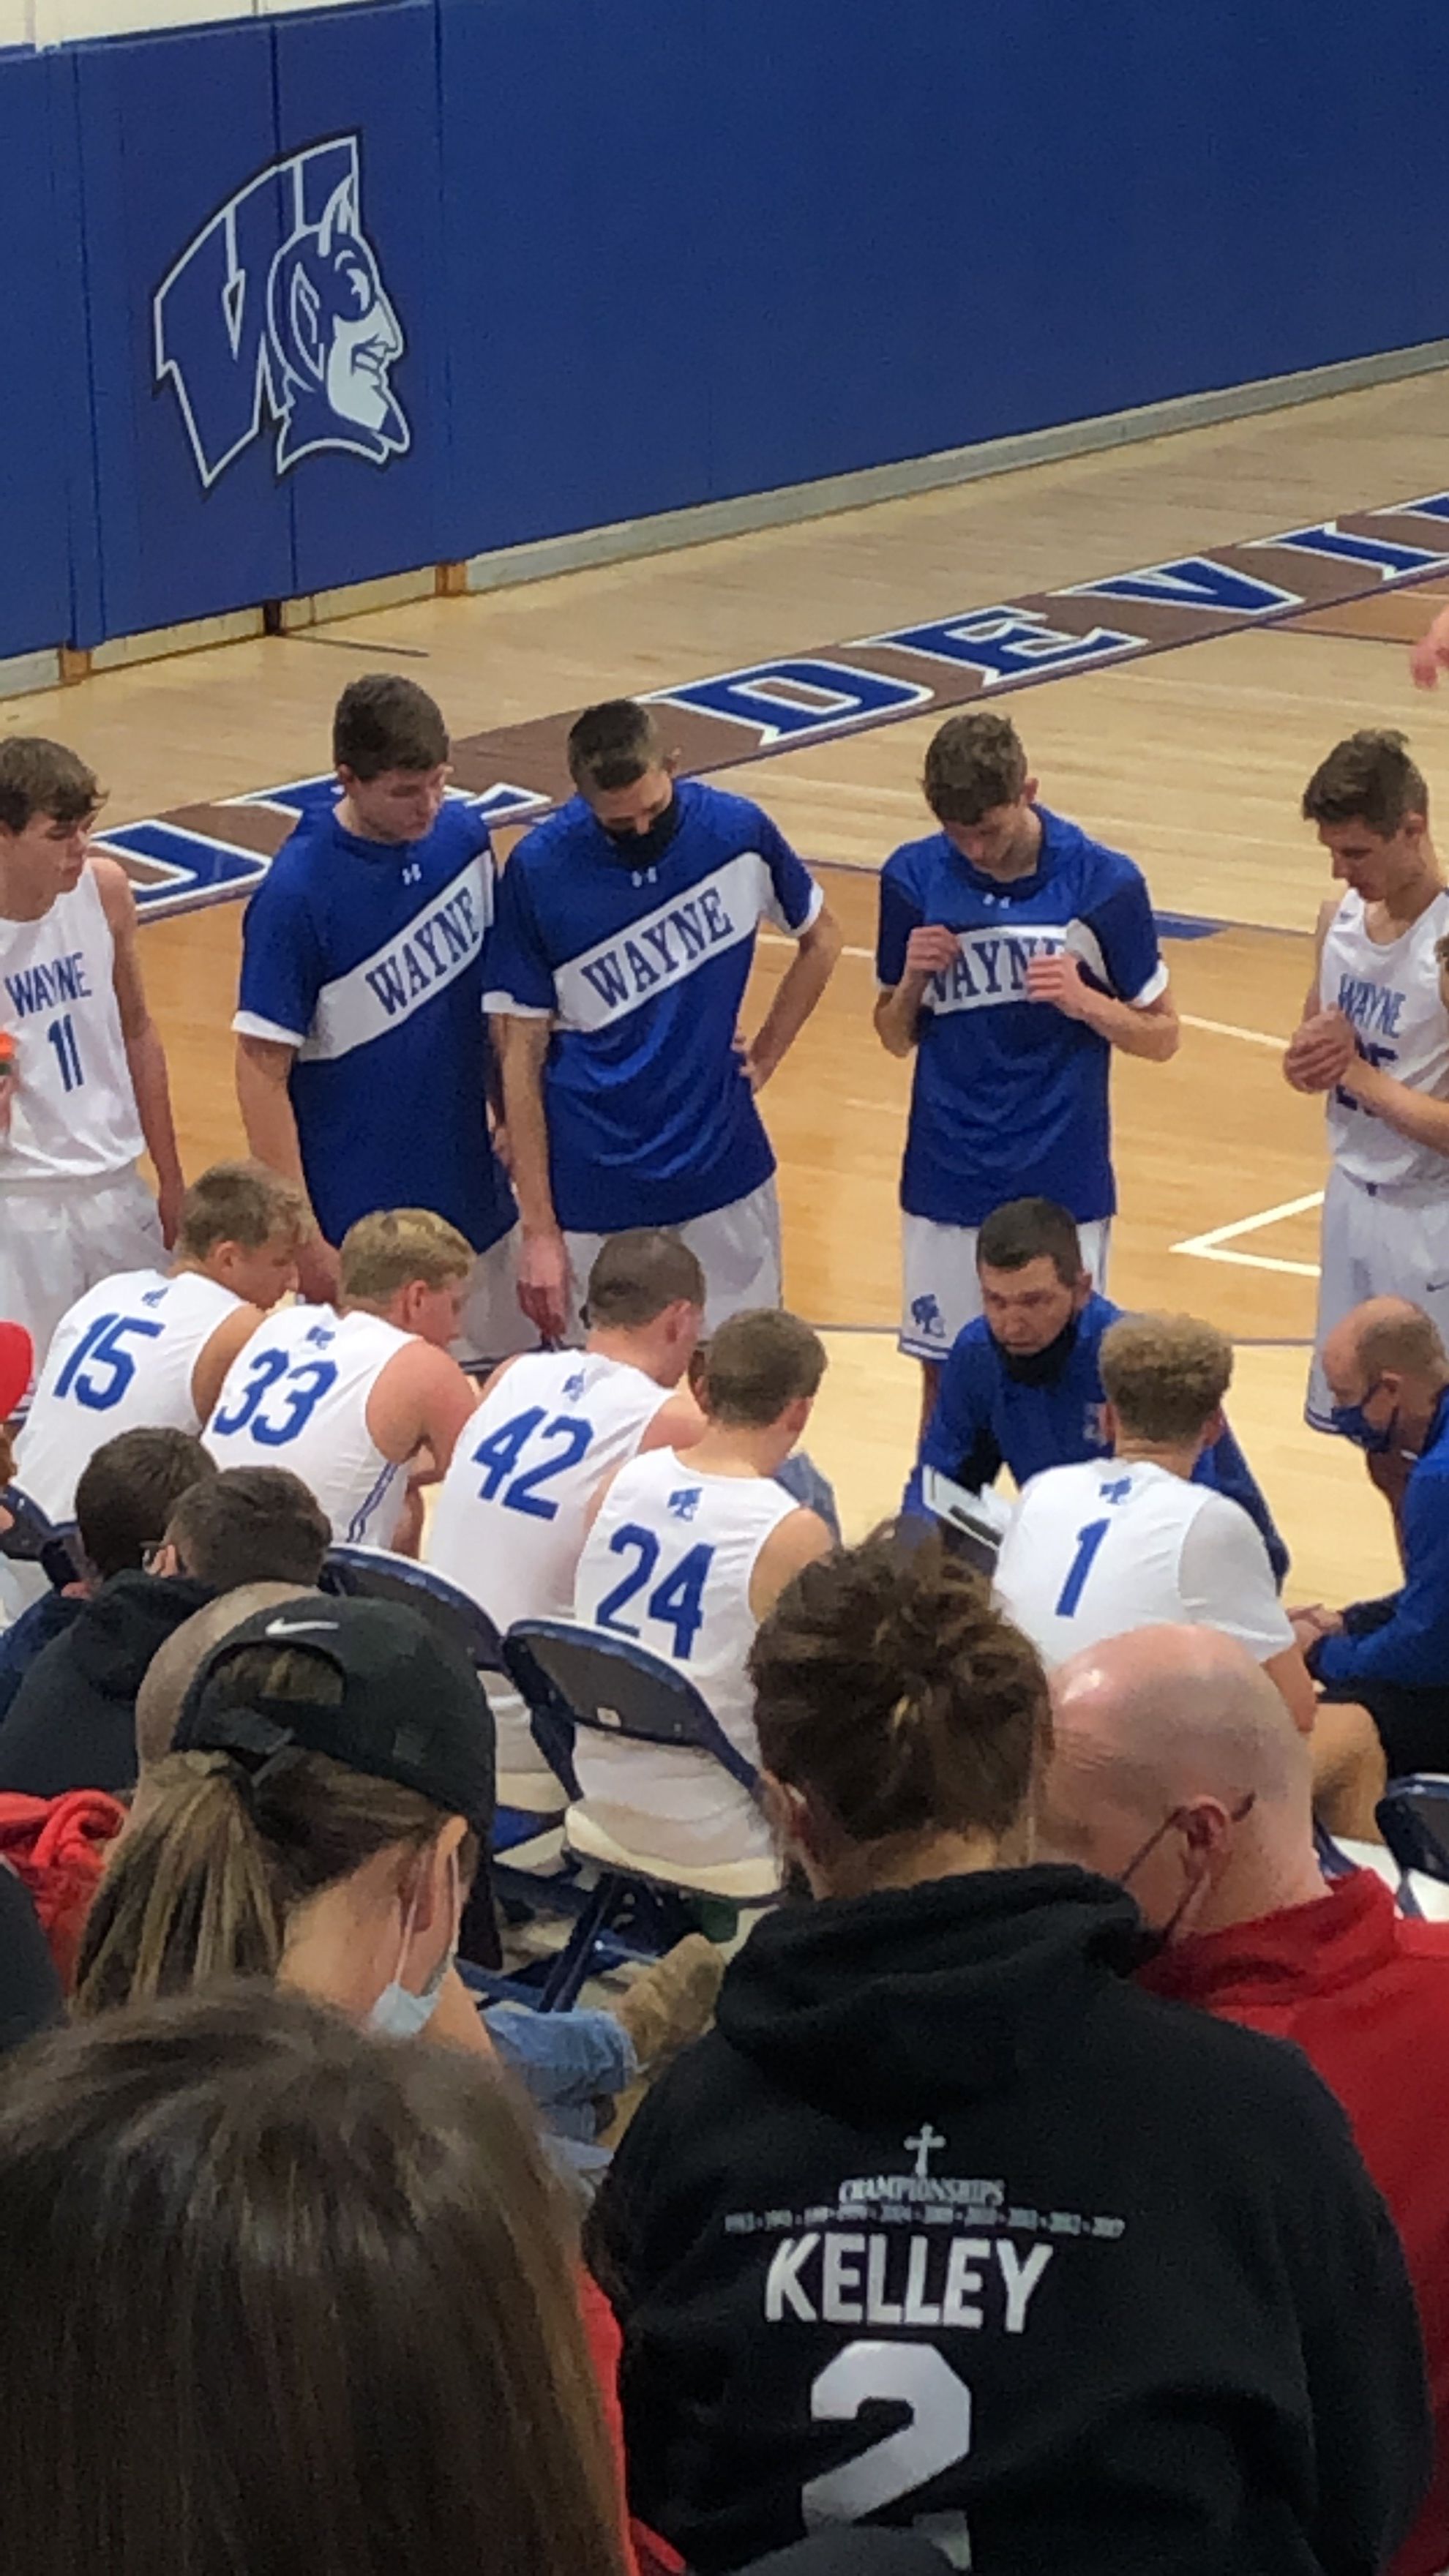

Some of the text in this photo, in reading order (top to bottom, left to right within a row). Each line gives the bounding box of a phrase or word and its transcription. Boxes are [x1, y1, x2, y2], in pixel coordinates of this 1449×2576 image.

[5, 952, 91, 1017] WAYNE
[365, 887, 479, 1016] WAYNE
[580, 887, 734, 1009] WAYNE
[48, 1014, 84, 1092] 11
[1338, 972, 1406, 1038] WAYNE
[53, 1313, 165, 1411] 15
[212, 1347, 338, 1446] 33
[471, 1406, 594, 1521] 42
[595, 1522, 716, 1660] 24
[1055, 1519, 1111, 1618] 1
[764, 2232, 1054, 2332] KELLEY
[802, 2340, 972, 2571] 2
